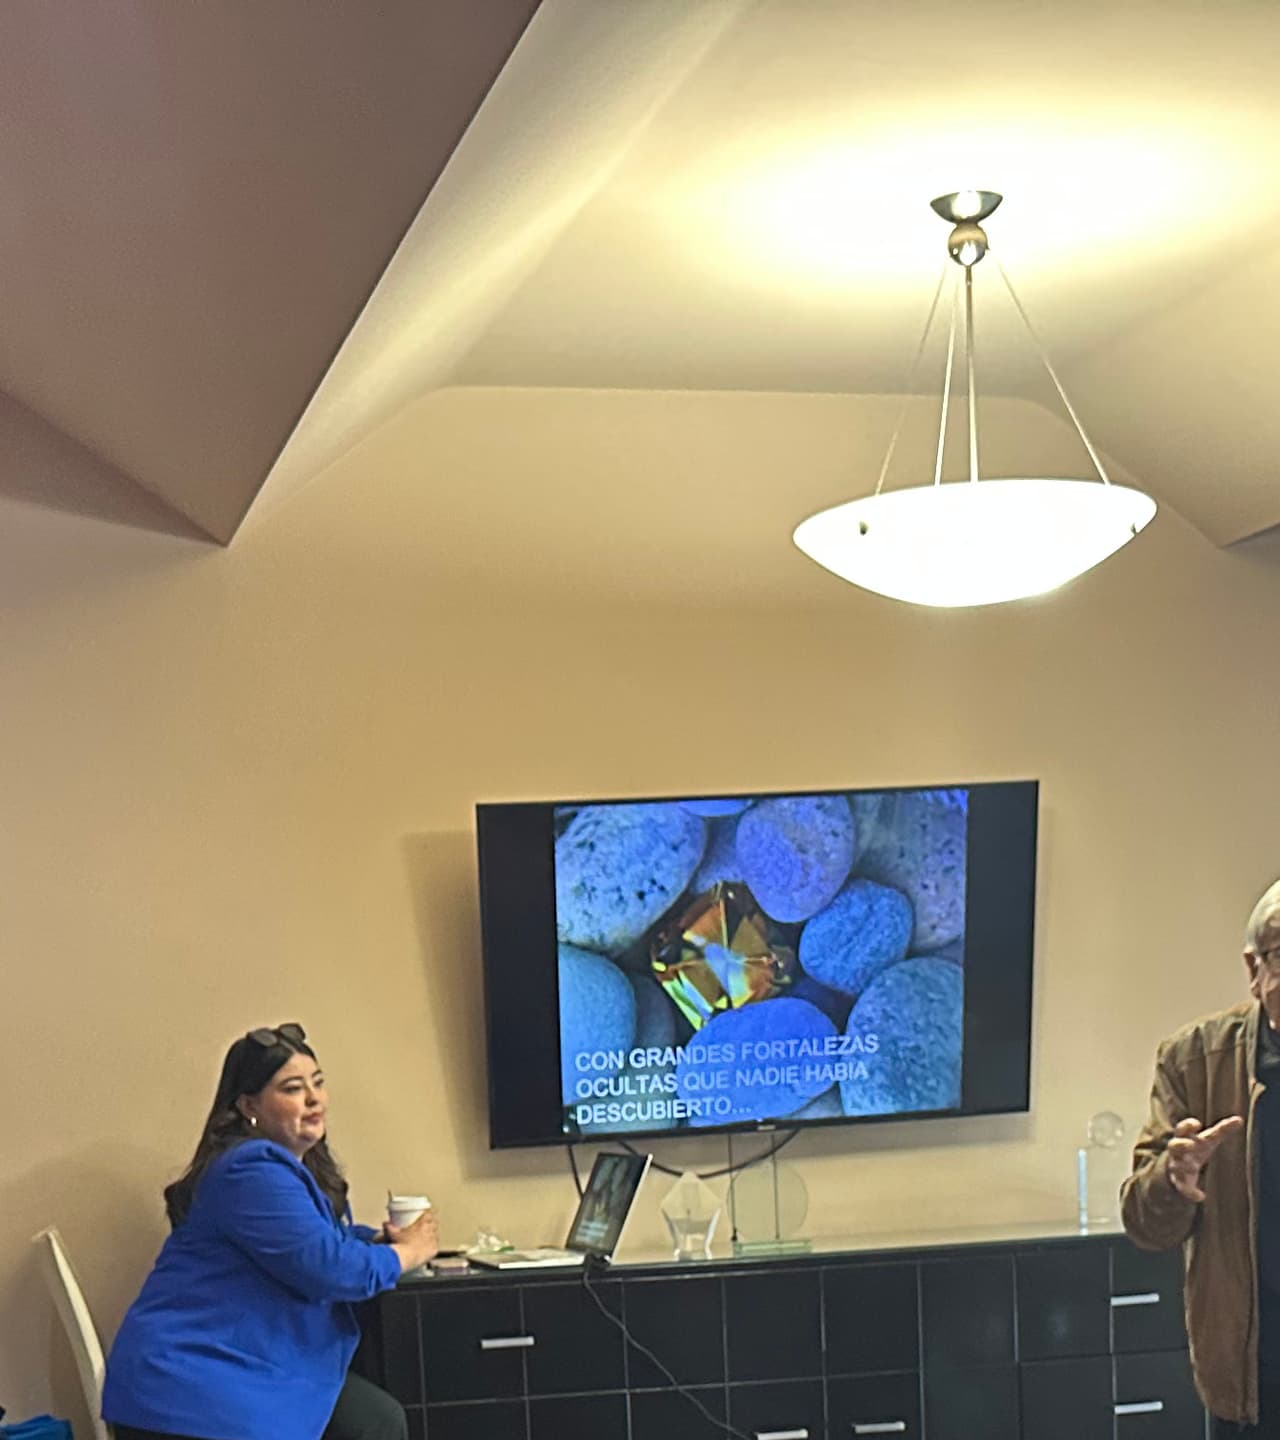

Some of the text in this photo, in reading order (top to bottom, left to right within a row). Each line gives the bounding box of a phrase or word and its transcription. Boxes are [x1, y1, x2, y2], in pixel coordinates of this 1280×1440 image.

[575, 1033, 881, 1072] CON GRANDES FORTALEZAS
[575, 1072, 679, 1098] OCULTAS
[683, 1070, 729, 1092] QUE
[735, 1064, 800, 1088] NADIE
[576, 1095, 752, 1125] DESCUBIERTO...
